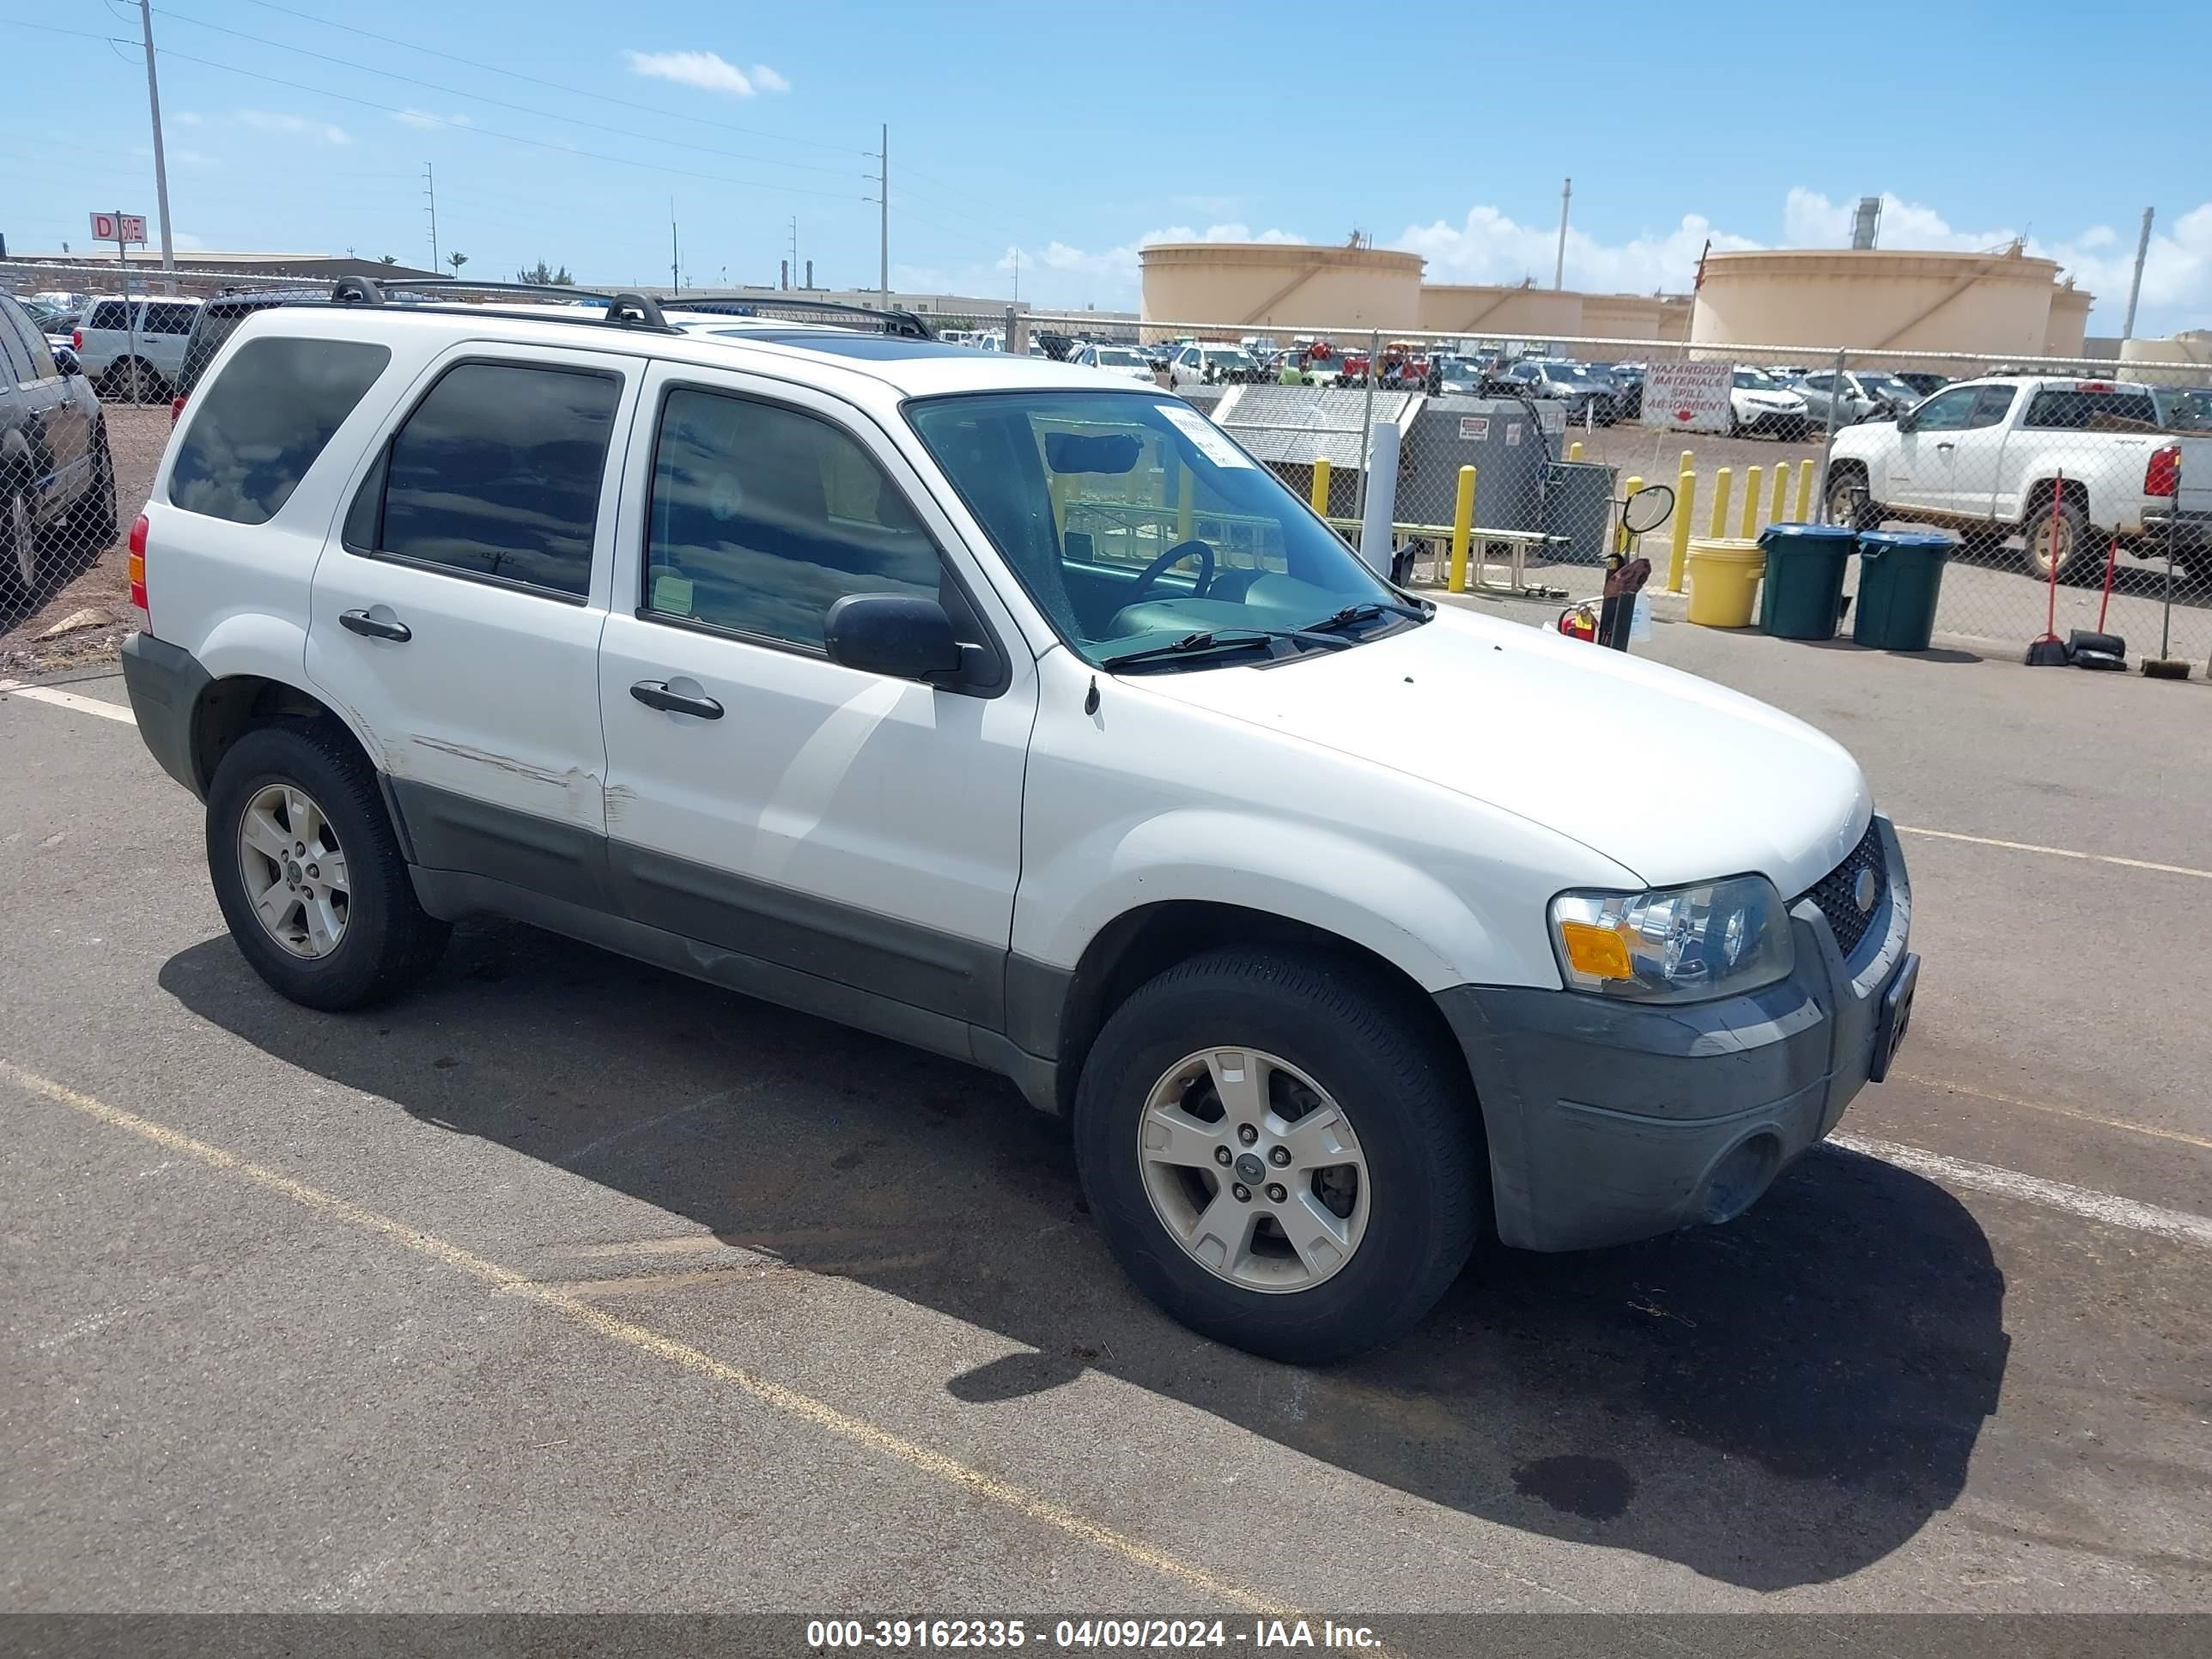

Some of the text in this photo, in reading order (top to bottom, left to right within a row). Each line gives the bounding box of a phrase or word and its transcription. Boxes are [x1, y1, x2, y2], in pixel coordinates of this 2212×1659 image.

[96, 216, 112, 237] D
[1650, 364, 1729, 376] HAZARDOUS
[1653, 376, 1723, 388] MATERIALS
[1671, 388, 1704, 399] SPILL
[1647, 398, 1726, 411] ABSORBENT
